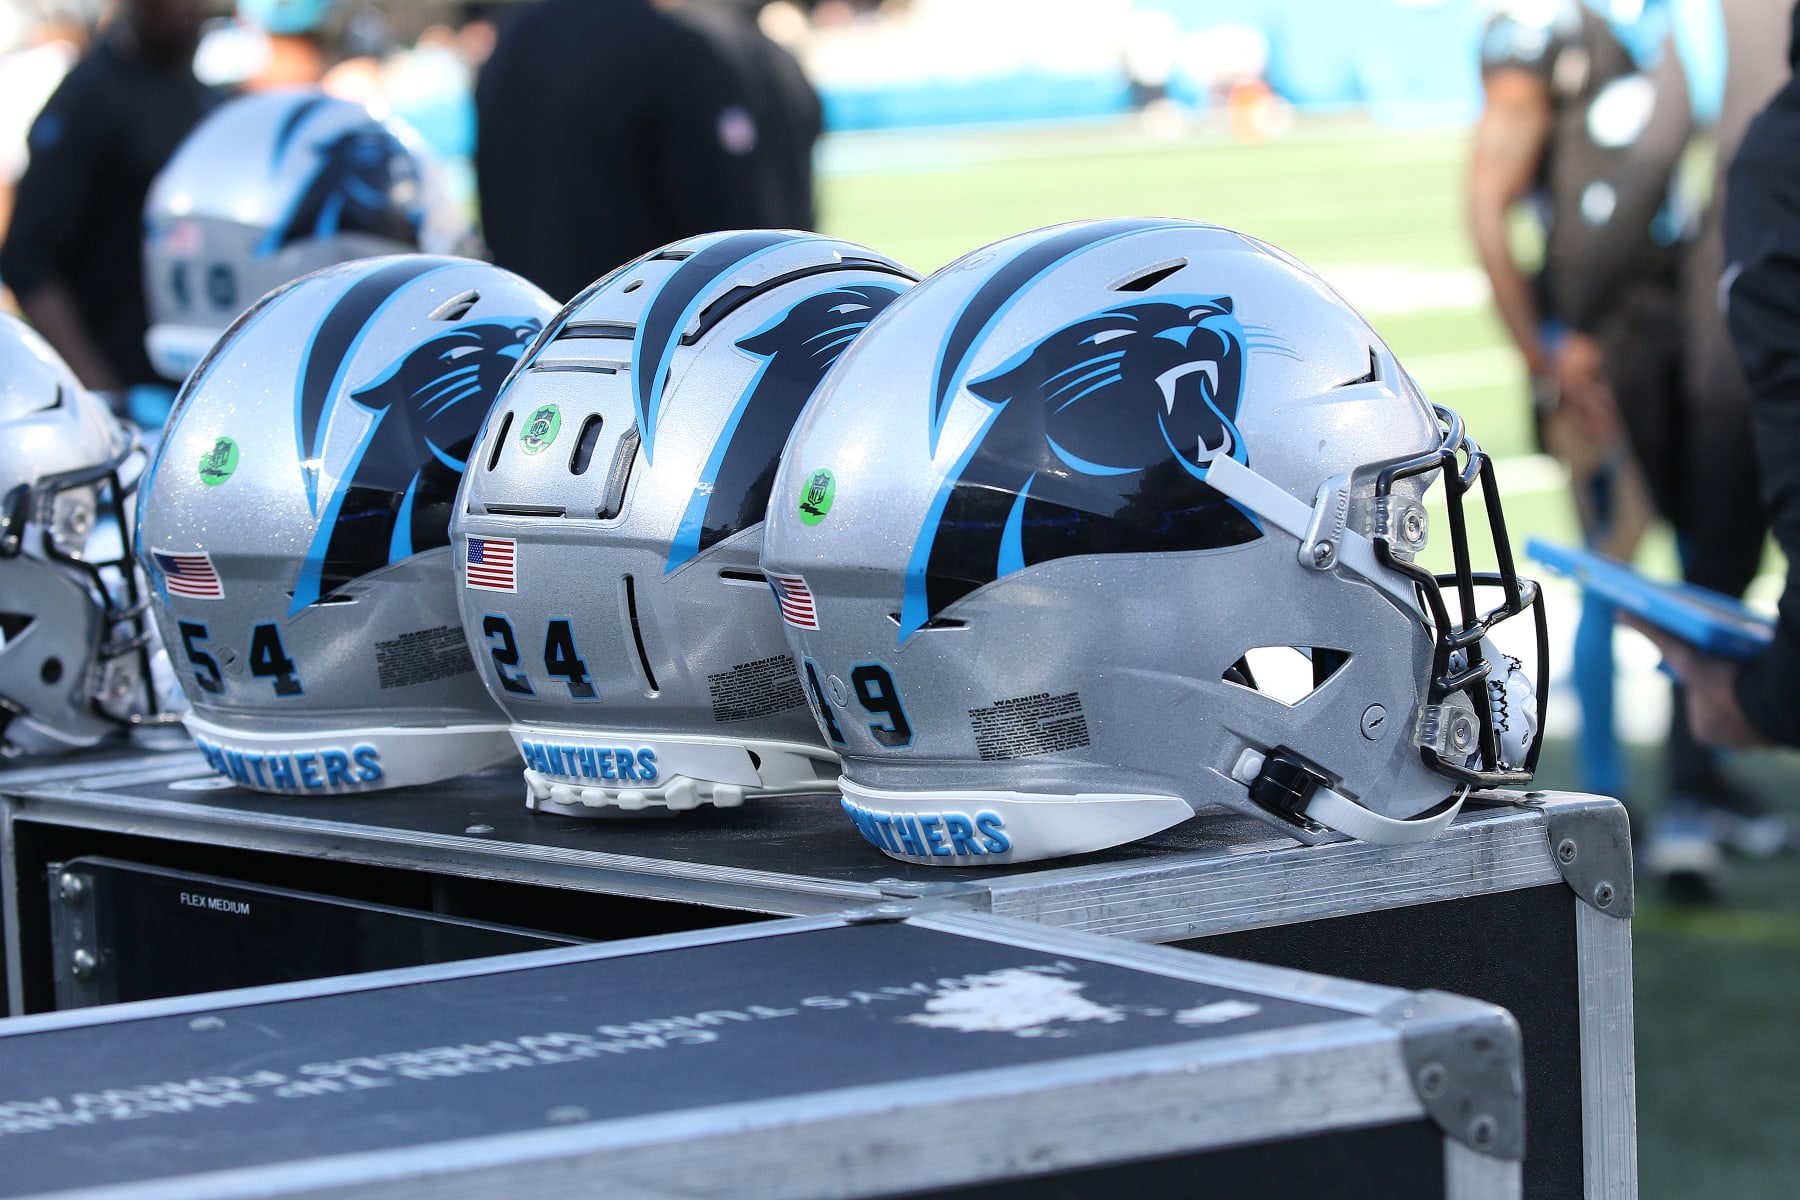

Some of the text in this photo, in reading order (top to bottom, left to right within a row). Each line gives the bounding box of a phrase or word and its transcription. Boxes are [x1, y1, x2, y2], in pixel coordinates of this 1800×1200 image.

[176, 619, 306, 697] 54
[482, 612, 601, 700] 24
[732, 654, 787, 671] WARNING
[993, 692, 1051, 707] WARNING
[521, 740, 659, 782] PANTHERS
[840, 797, 1012, 858] NTHERS
[180, 892, 251, 915] FLEX MEDIUM
